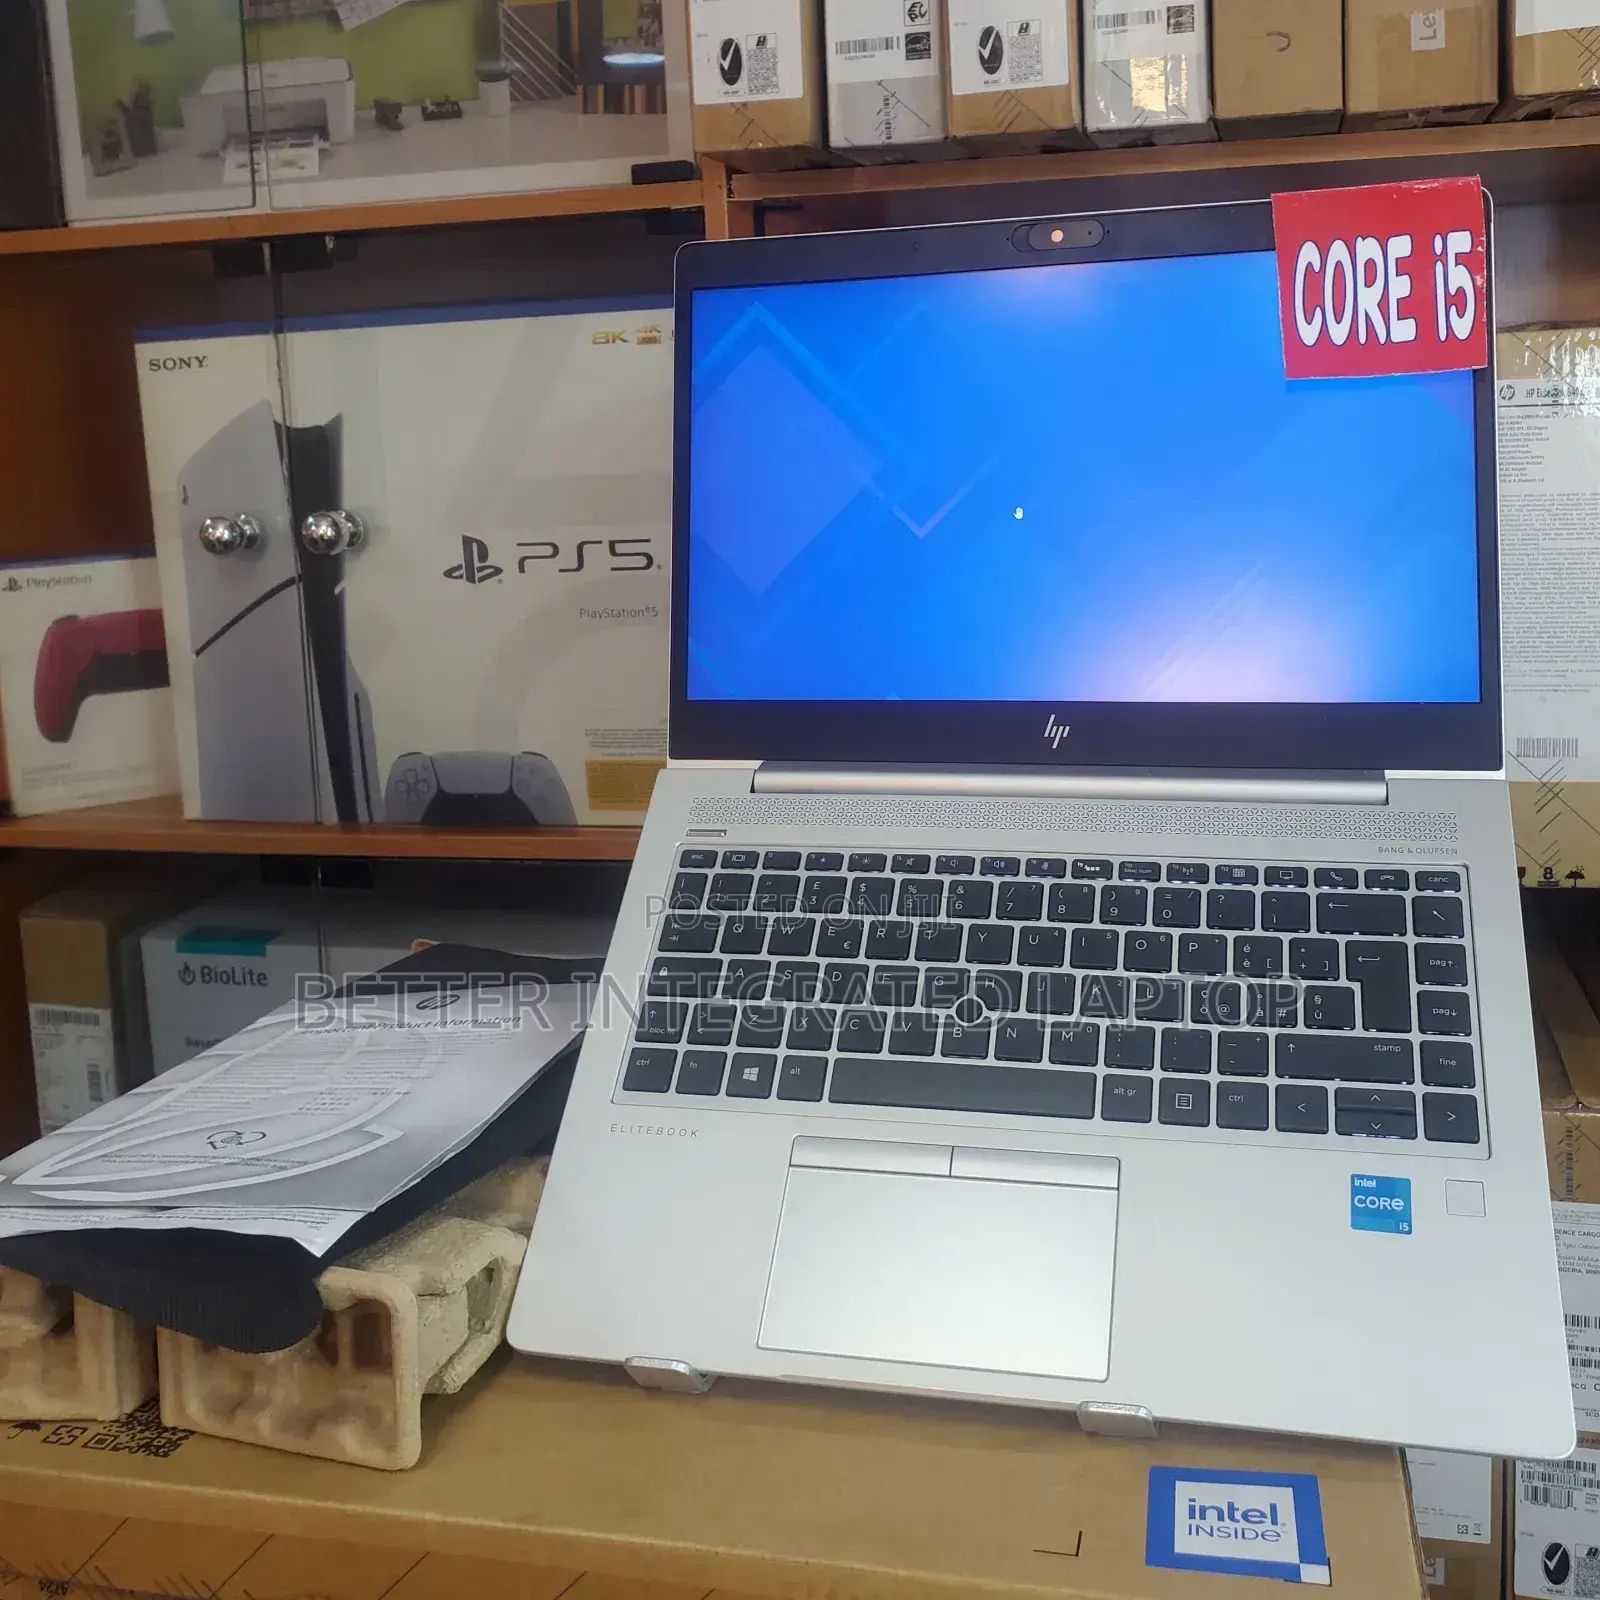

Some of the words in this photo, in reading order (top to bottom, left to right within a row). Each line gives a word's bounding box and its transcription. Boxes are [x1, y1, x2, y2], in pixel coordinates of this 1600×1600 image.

[1294, 233, 1417, 347] CORE
[1433, 229, 1477, 342] i5
[592, 330, 629, 344] 8K
[149, 355, 207, 372] SONY
[516, 538, 654, 574] PS5
[1378, 846, 1404, 854] BANG
[1415, 847, 1458, 855] OLUFSEN
[955, 901, 963, 910] 6
[1006, 903, 1014, 912] 7
[1057, 905, 1066, 914] 8
[1109, 906, 1118, 916] 9
[733, 923, 744, 934] Q
[781, 925, 795, 935] W
[827, 926, 837, 936] E
[876, 928, 886, 939] R
[978, 932, 988, 942] Y
[1029, 934, 1039, 945] U
[1135, 939, 1147, 950] O
[1189, 942, 1198, 952] P
[200, 965, 268, 987] BioLite
[734, 968, 745, 978] A
[783, 970, 793, 980] S
[832, 972, 843, 982] D
[934, 976, 945, 986] G
[985, 978, 995, 989] H
[1037, 981, 1045, 992] J
[1092, 984, 1102, 995] K
[749, 1015, 759, 1025] Z
[799, 1017, 809, 1028] X
[850, 1019, 860, 1030] C
[902, 1021, 912, 1032] V
[953, 1027, 963, 1038] B
[1006, 1028, 1017, 1039] N
[1062, 1031, 1073, 1042] M
[1373, 1043, 1401, 1053] stamp
[636, 1058, 650, 1067] ctrl
[689, 1060, 698, 1069] fn
[1439, 1057, 1457, 1066] fine
[1113, 1087, 1125, 1095] alt
[1127, 1088, 1137, 1096] gr
[1228, 1094, 1244, 1102] ctrl
[610, 1123, 698, 1138] ELITEBOOK
[1354, 1177, 1377, 1188] intel
[1399, 1222, 1409, 1232] i5
[1188, 1498, 1279, 1526] intel
